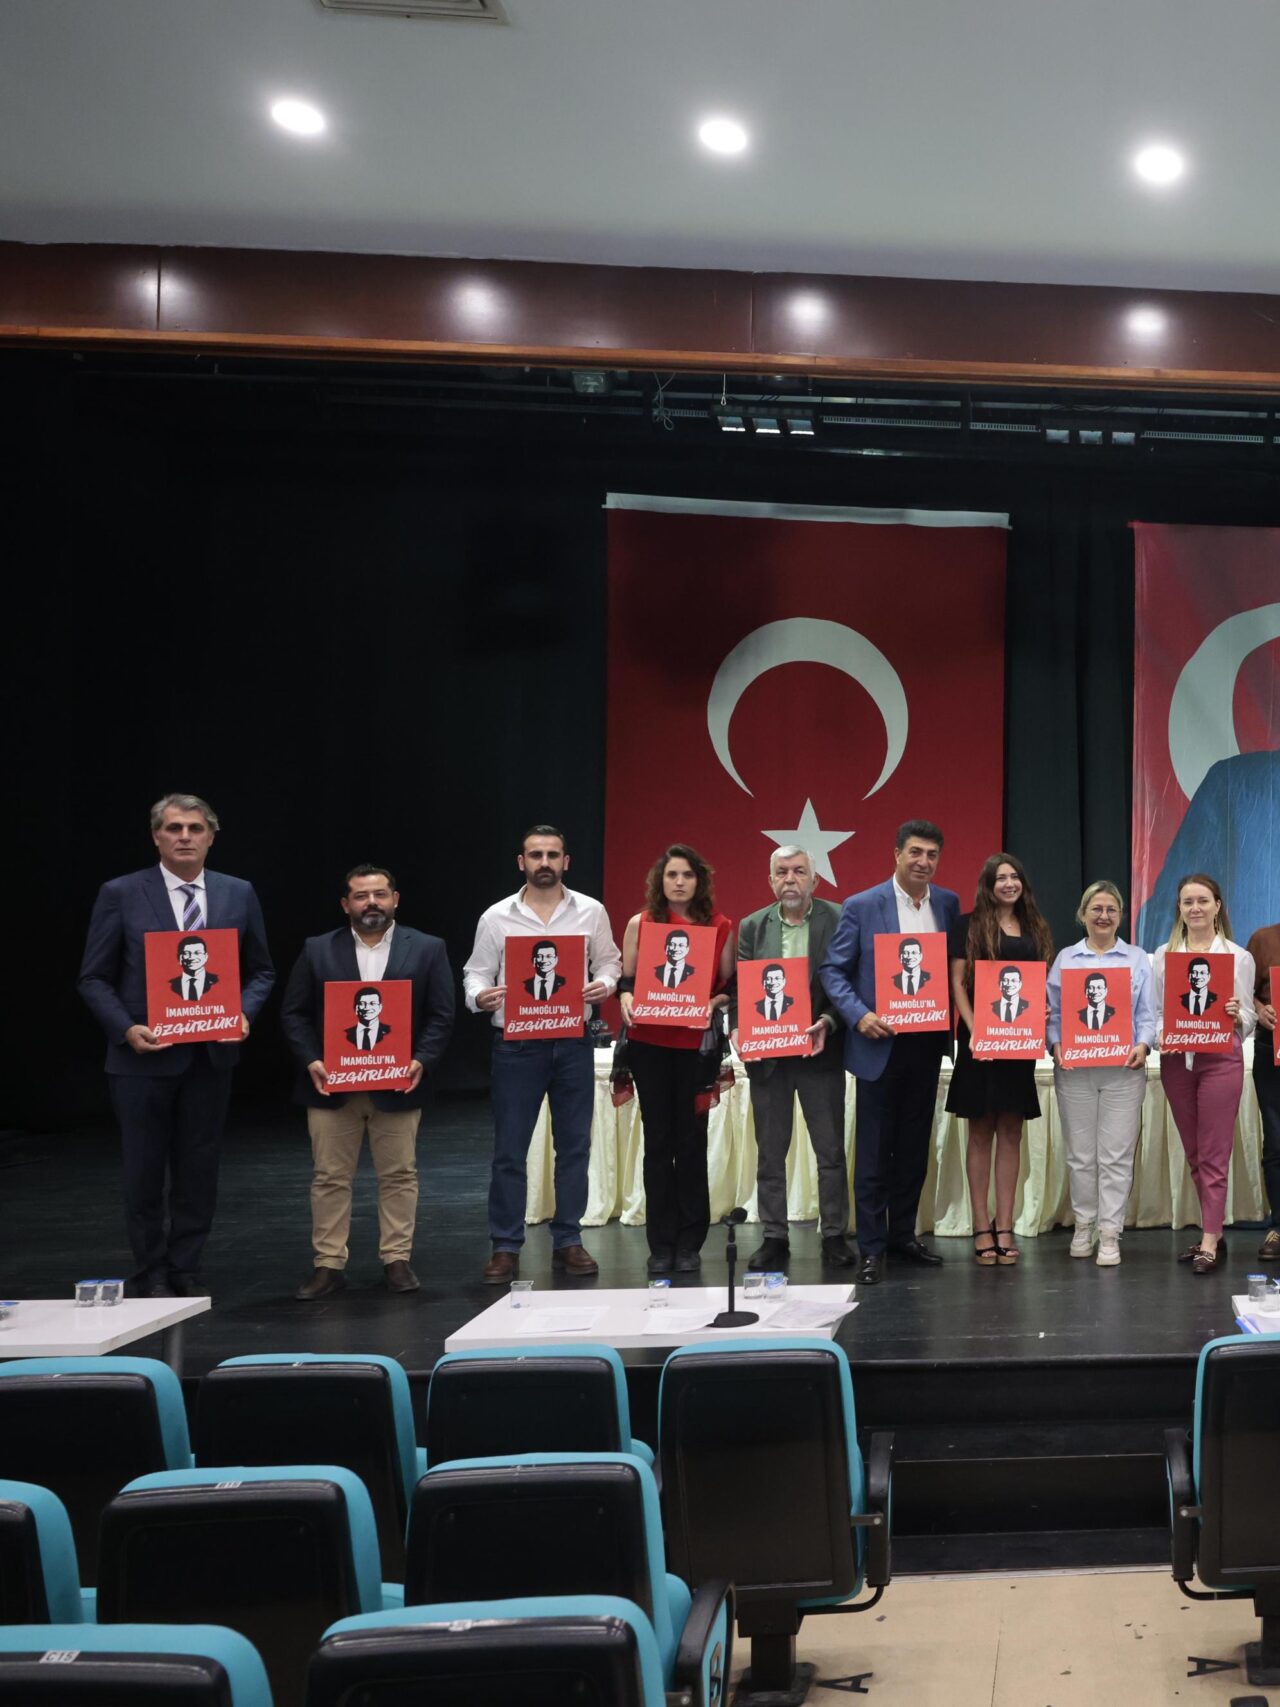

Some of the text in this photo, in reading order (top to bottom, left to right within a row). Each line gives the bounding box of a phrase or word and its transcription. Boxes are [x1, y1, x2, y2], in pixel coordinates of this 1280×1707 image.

[648, 992, 695, 1003] İMAMOĞLU'NA
[519, 1005, 569, 1015] İMAMOĞLU'NA
[890, 1000, 935, 1009] İMAMOĞLU'NA
[166, 1005, 225, 1017] İMAMOĞLU'NA
[634, 1005, 705, 1017] ÖZGÜRLÜK!
[154, 1016, 238, 1036] ÖZGÜRLÜK!
[507, 1016, 581, 1033] ÖZGÜRLÜK!
[752, 1024, 798, 1035] İMAMOĞLU'NA
[1176, 1019, 1220, 1030] İMAMOĞLU'NA
[987, 1027, 1032, 1036] İMAMOĞLU'NA
[742, 1034, 808, 1053] ÖZGÜRLÜK!
[1075, 1033, 1119, 1044] İMAMOĞLU'NA
[1165, 1032, 1231, 1045] ÖZGÜRLÜK!
[976, 1039, 1043, 1052] ÖZGÜRLÜK!
[1065, 1045, 1130, 1060] ÖZGÜRLÜK!
[341, 1055, 395, 1065] İMAMOĞLU'NA
[328, 1066, 407, 1085] ÖZGÜRLÜK!
